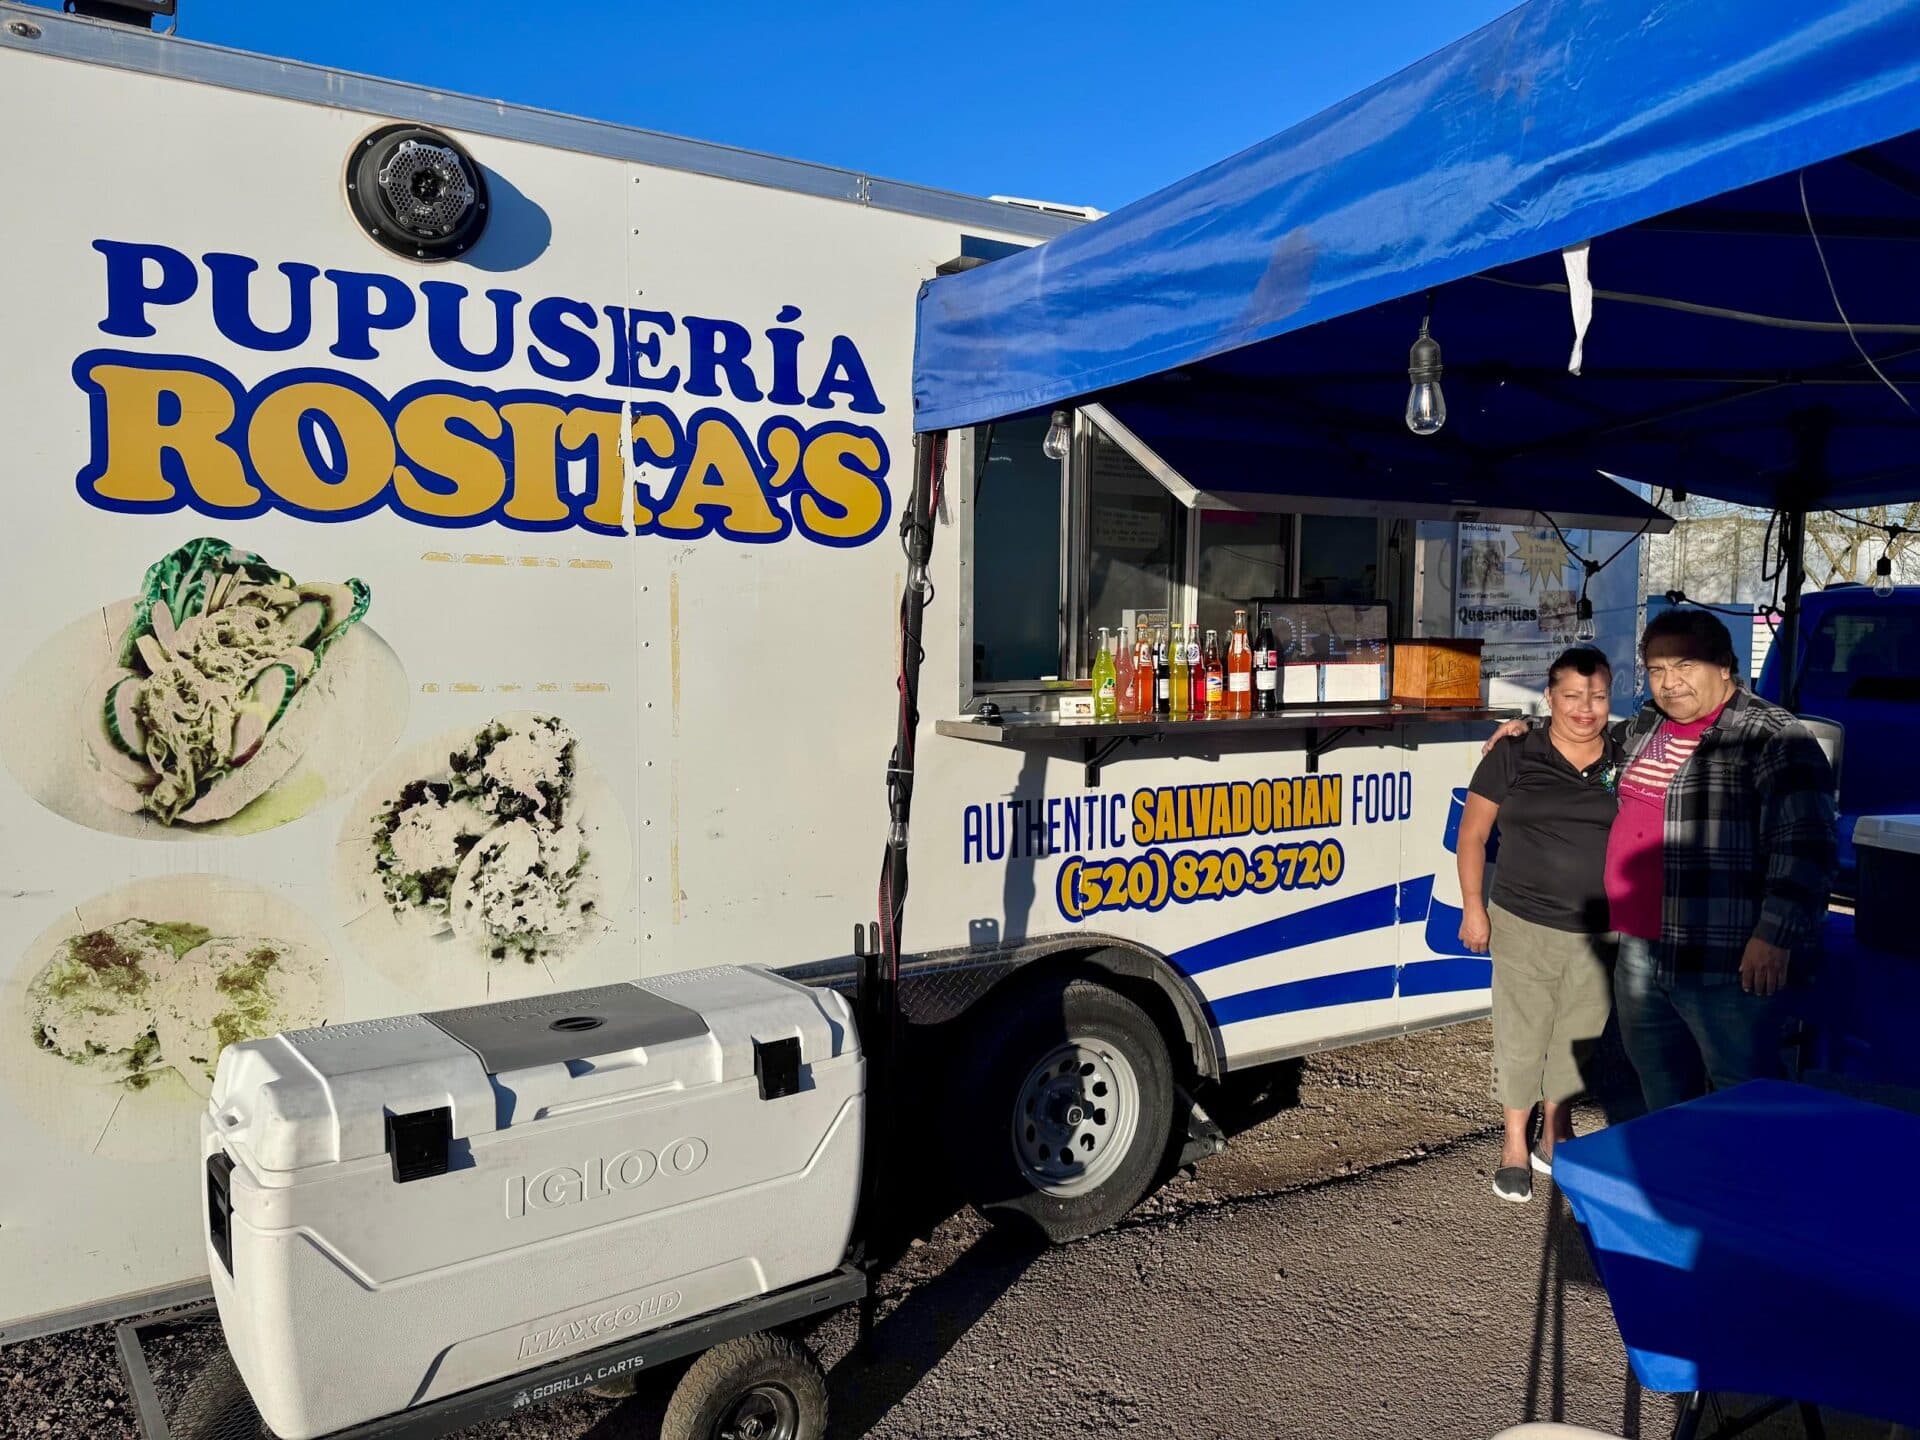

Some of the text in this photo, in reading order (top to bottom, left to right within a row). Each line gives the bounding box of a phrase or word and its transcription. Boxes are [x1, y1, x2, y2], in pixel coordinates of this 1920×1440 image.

[92, 238, 886, 413] PUPUSERÍA
[72, 349, 891, 548] ROSITA'S
[963, 771, 1412, 865] AUTHENTIC SALVADORIAN FOOD
[505, 1137, 709, 1219] IGLOO
[518, 1291, 682, 1360] MAXCOLD
[533, 1356, 644, 1400] GORILLA CARTS
